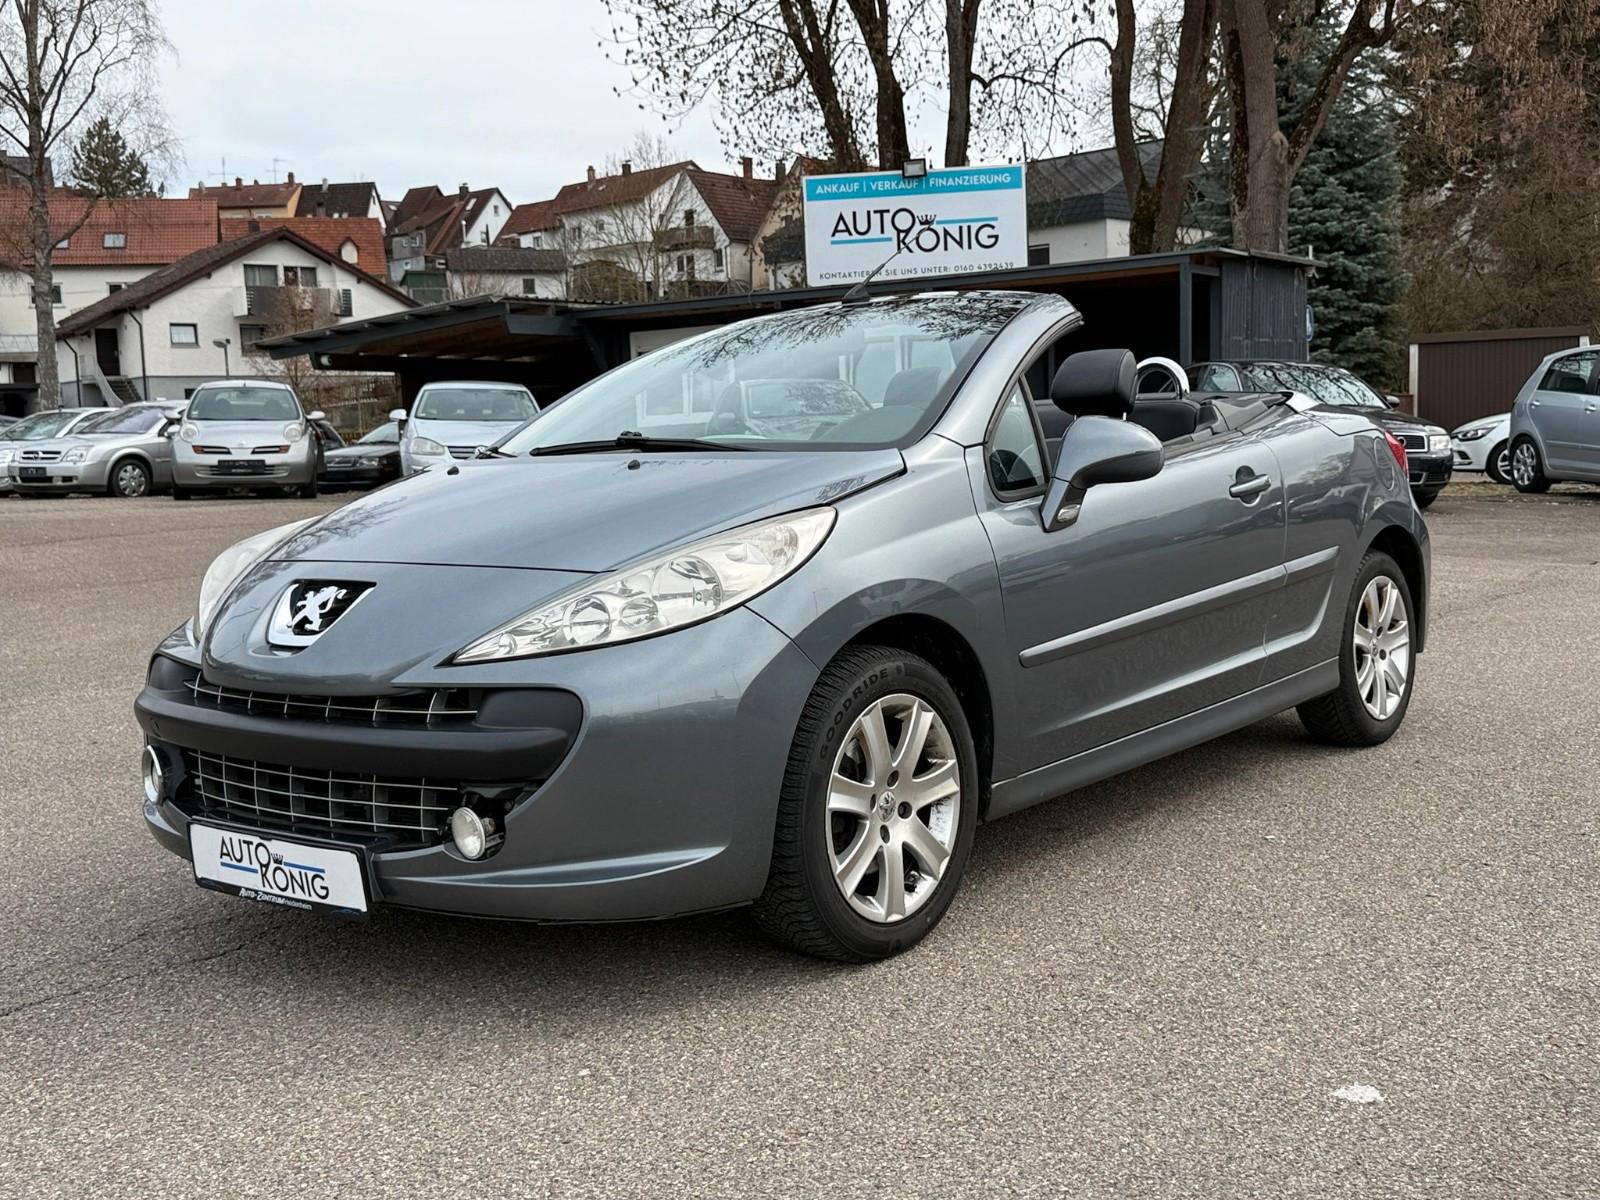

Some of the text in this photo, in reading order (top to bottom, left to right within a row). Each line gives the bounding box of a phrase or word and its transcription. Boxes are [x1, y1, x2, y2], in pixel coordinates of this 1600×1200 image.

[815, 173, 1012, 194] ANKAUF VERKAUF FINANZIERUNG
[831, 207, 915, 237] AUTO
[885, 268, 897, 276] SIE
[900, 267, 918, 275] UNS
[921, 265, 951, 274] UNTER:
[953, 264, 974, 272] 0160
[820, 668, 888, 759] GOODRIDE
[220, 836, 271, 866] AUTO
